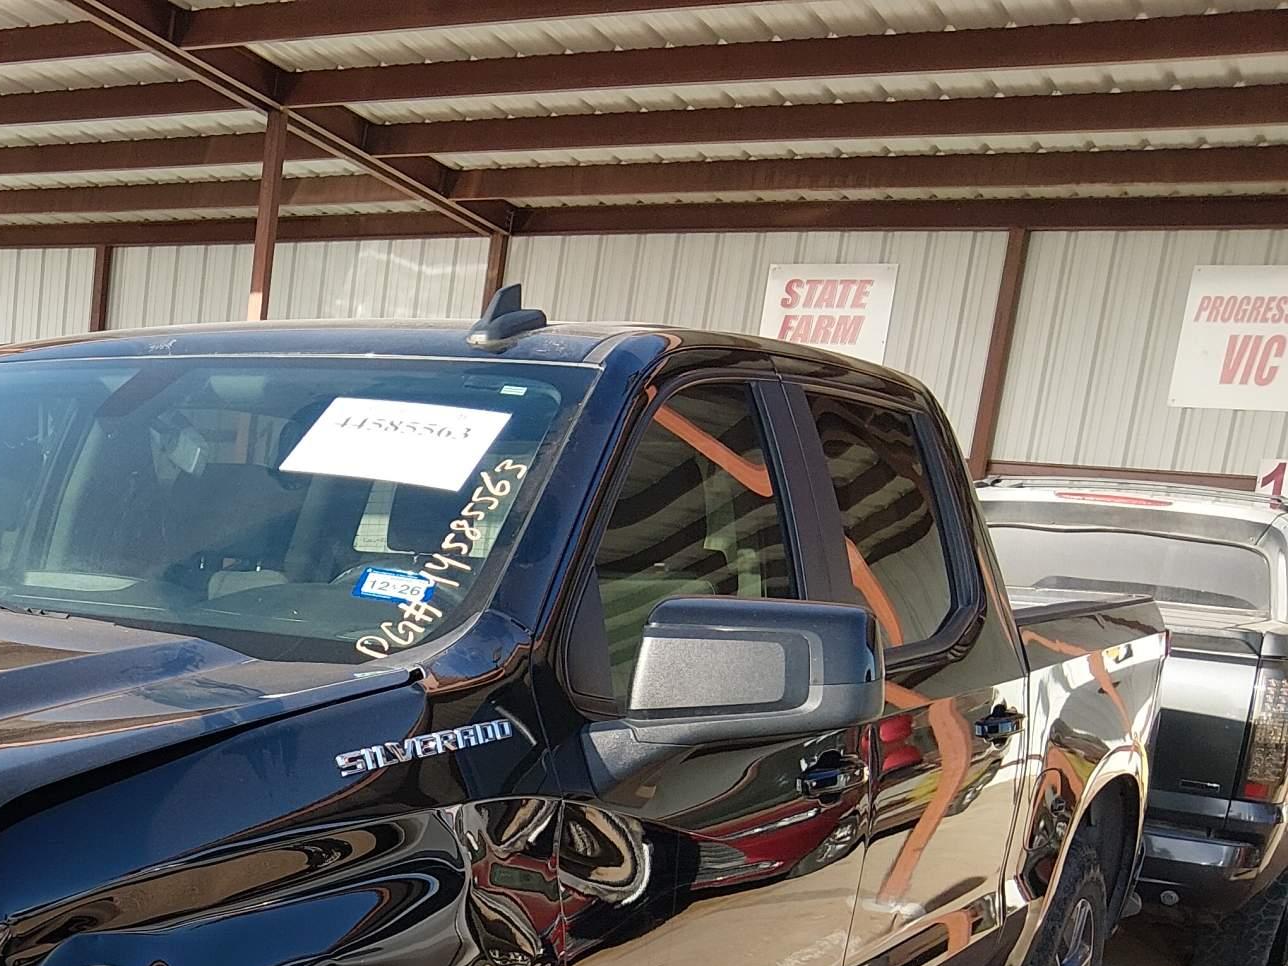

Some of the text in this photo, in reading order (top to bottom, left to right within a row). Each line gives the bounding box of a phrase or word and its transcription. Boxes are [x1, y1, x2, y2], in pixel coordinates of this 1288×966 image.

[780, 279, 874, 309] STATE
[1193, 295, 1288, 324] PROGRES
[777, 315, 866, 345] FARM
[1219, 334, 1287, 386] VIC
[335, 417, 472, 439] 44585563
[335, 719, 513, 778] SILVERADO
